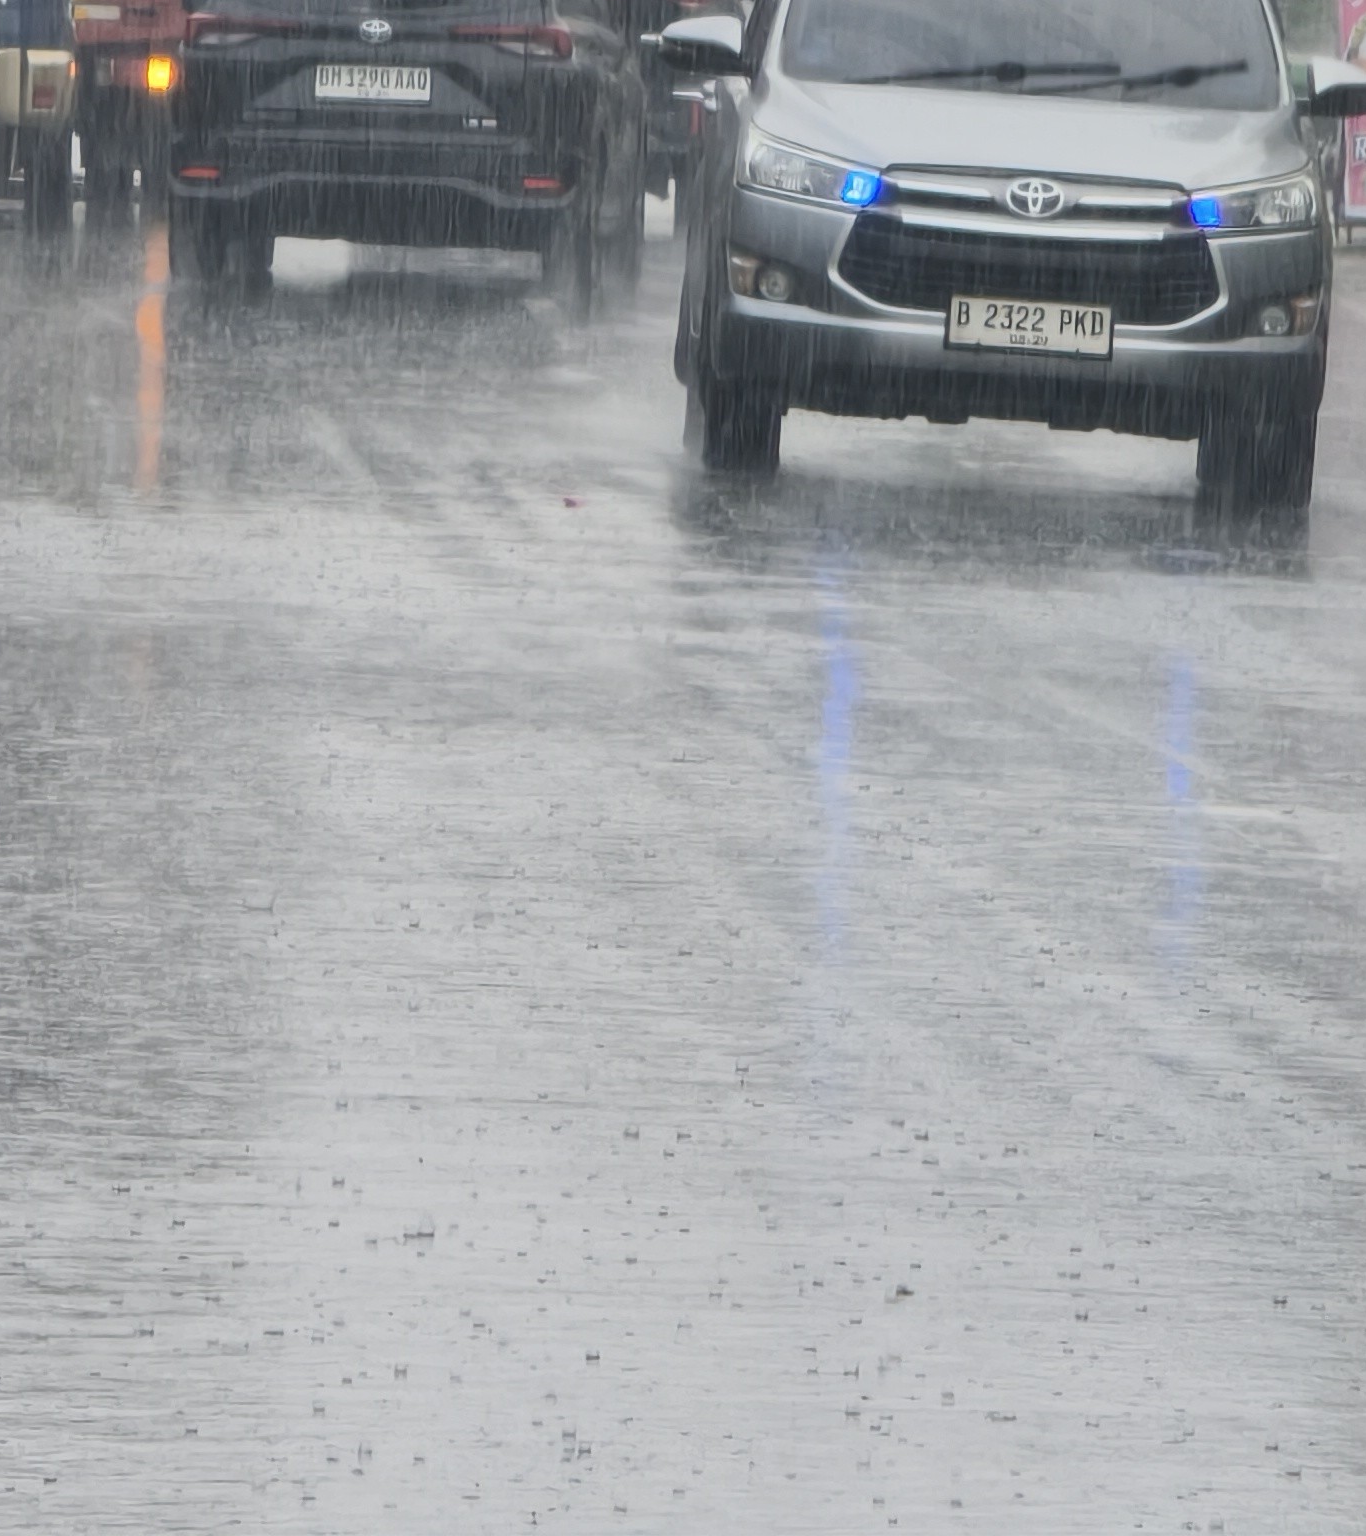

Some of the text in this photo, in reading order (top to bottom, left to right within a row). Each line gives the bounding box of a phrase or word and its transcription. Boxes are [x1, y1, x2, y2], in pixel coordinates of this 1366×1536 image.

[957, 300, 1105, 338] B 2322 PKD
